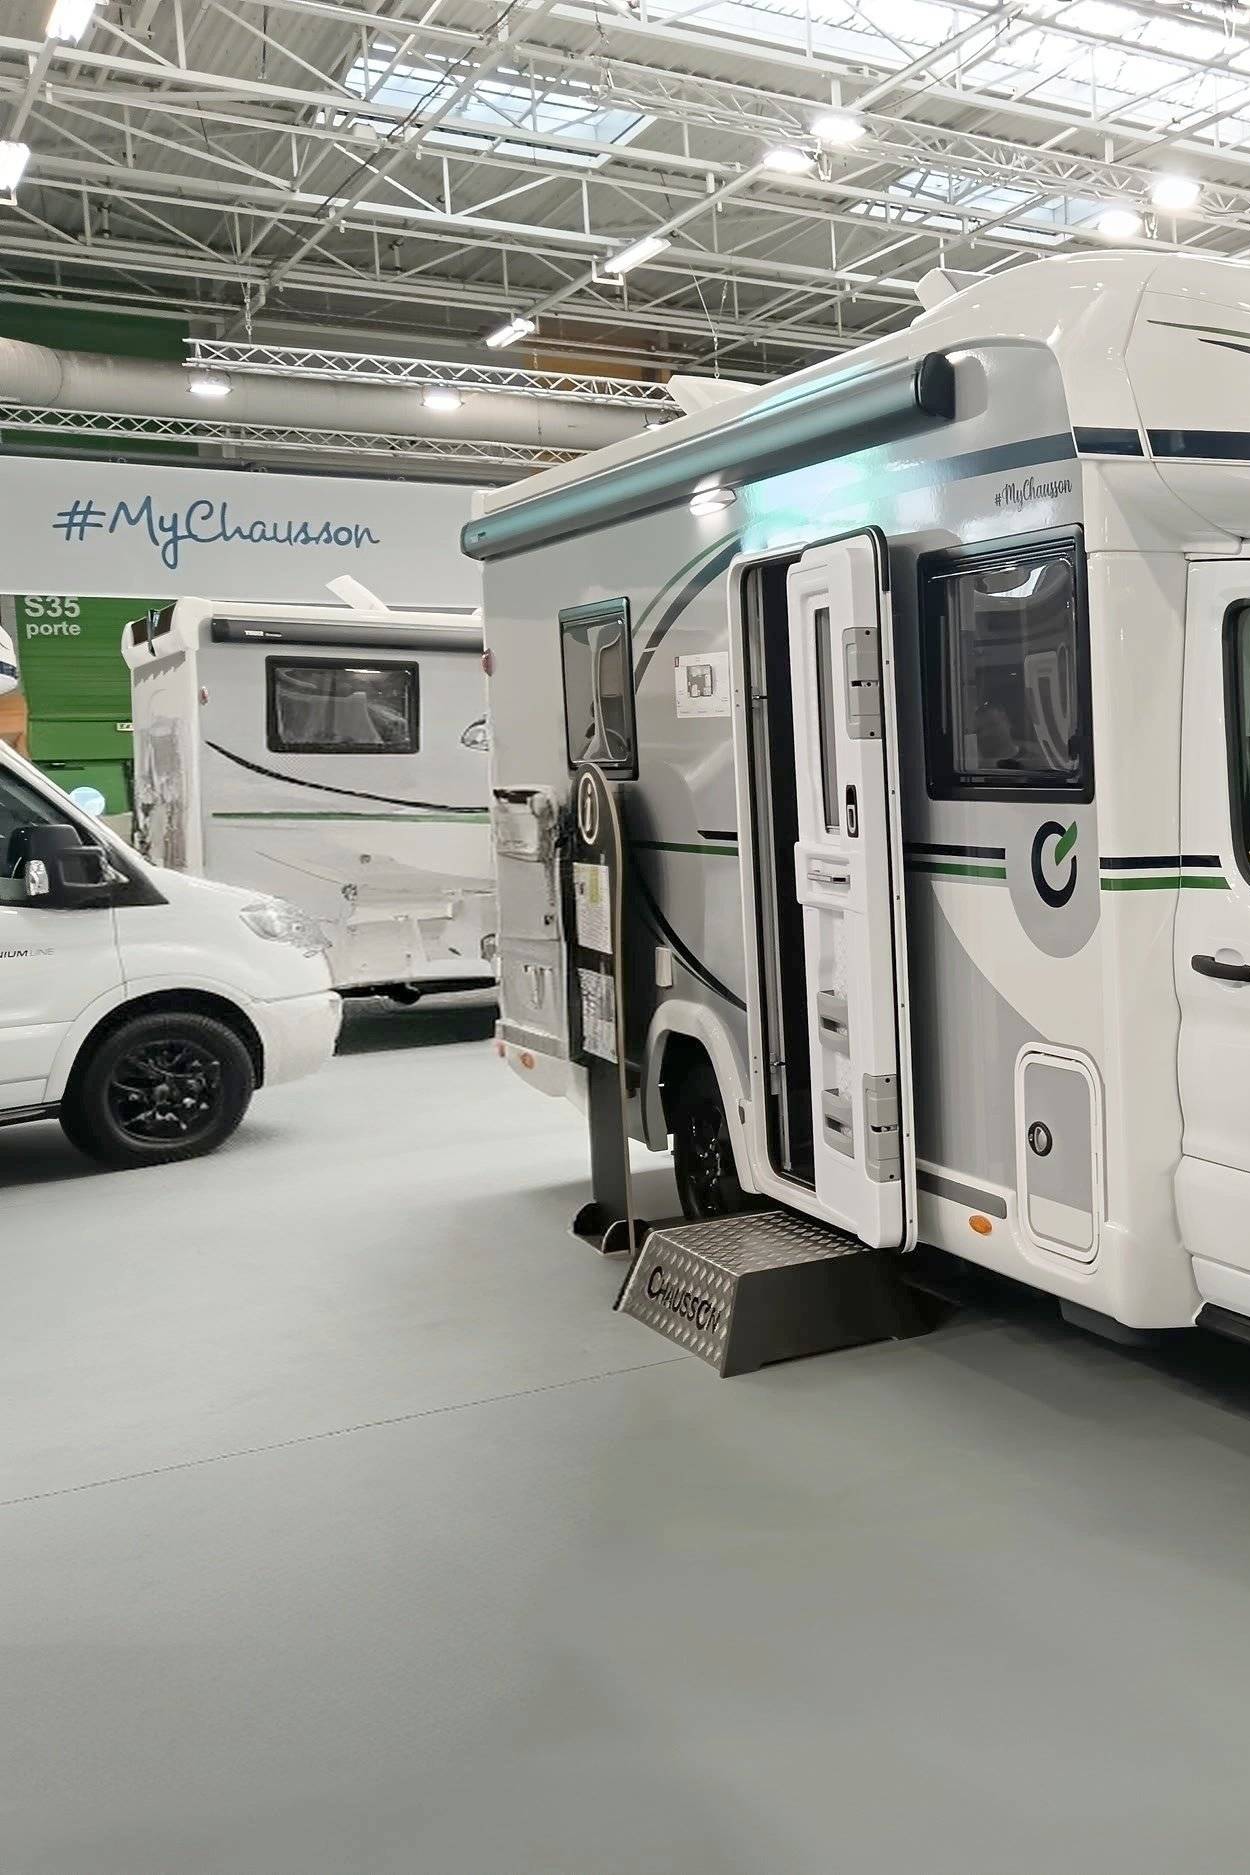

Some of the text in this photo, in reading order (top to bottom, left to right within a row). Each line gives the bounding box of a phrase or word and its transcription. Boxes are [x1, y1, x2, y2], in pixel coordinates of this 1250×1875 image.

[994, 476, 1072, 512] #MyChausson
[52, 496, 380, 569] #MyChausson
[24, 595, 80, 617] S35
[26, 621, 80, 639] porte
[647, 1266, 722, 1334] CHAUSSON
